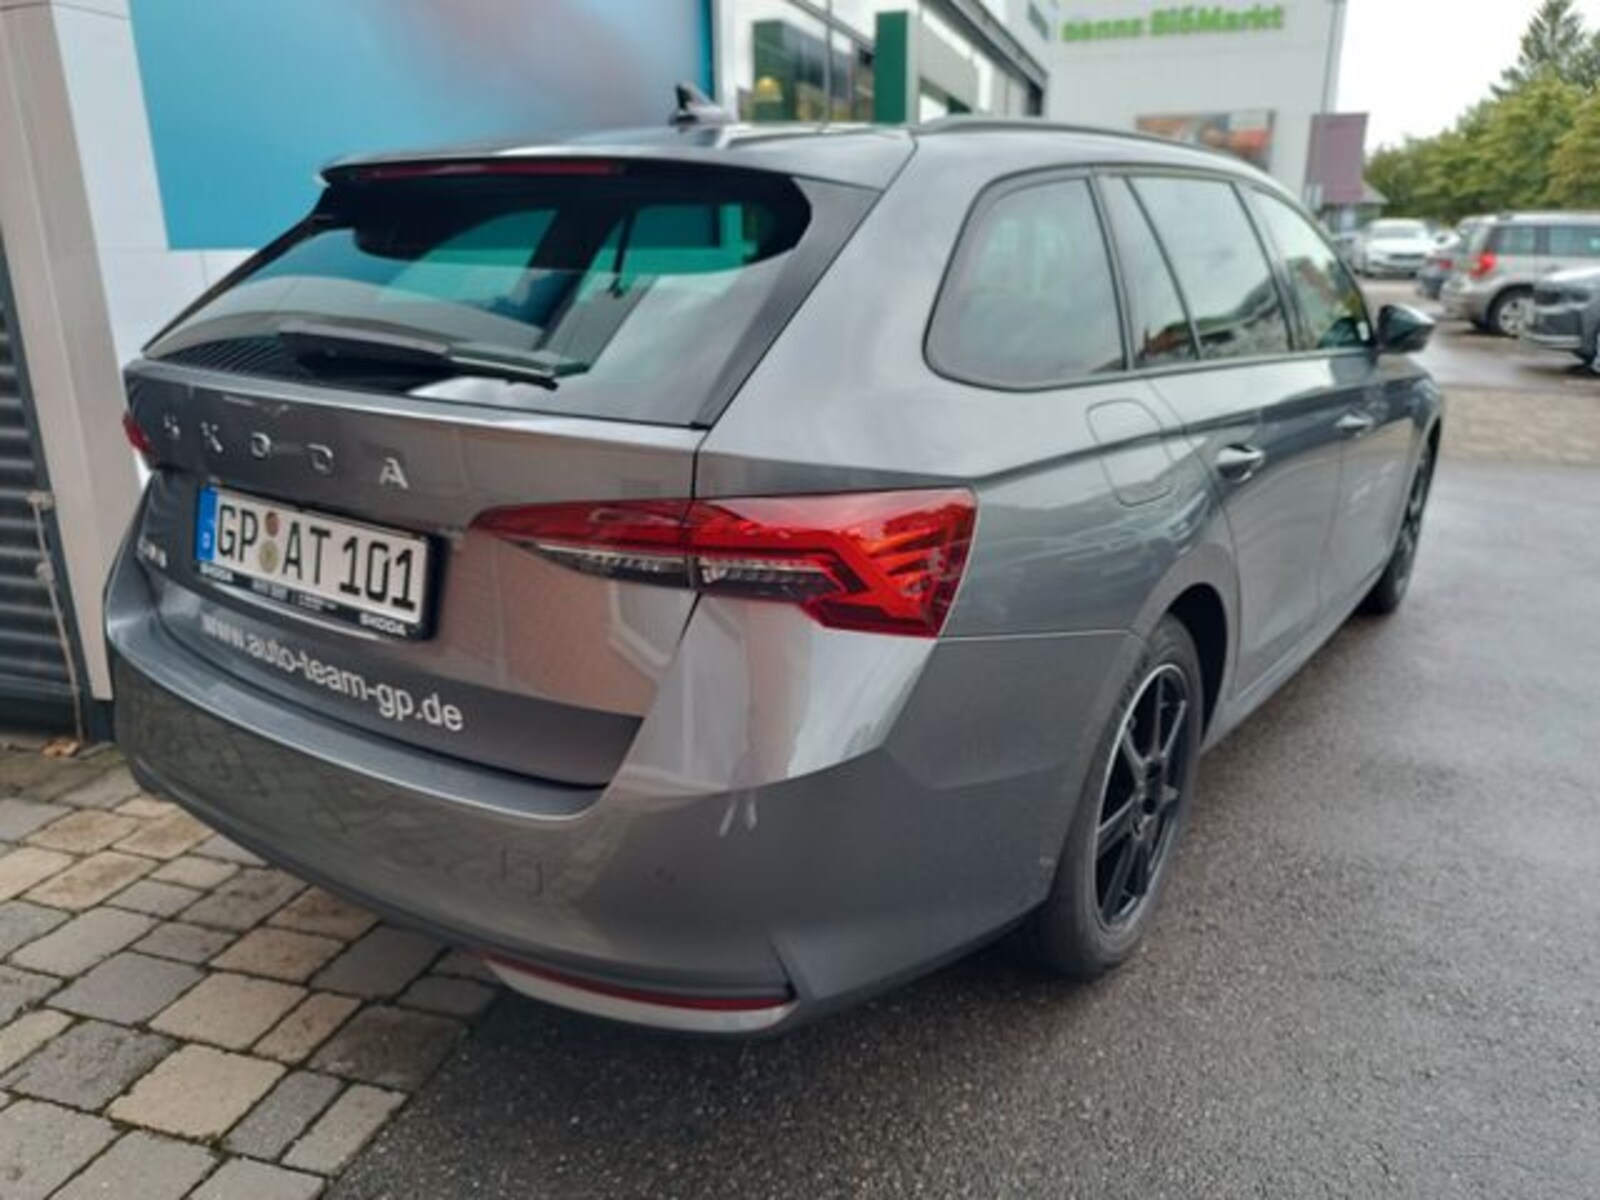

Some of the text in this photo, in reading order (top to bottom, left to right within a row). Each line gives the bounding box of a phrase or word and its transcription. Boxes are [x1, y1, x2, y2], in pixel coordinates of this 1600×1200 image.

[217, 504, 258, 562] GP
[282, 521, 331, 585] AT
[339, 536, 415, 612] 101
[201, 612, 464, 732] www.auto-team-gp.de
